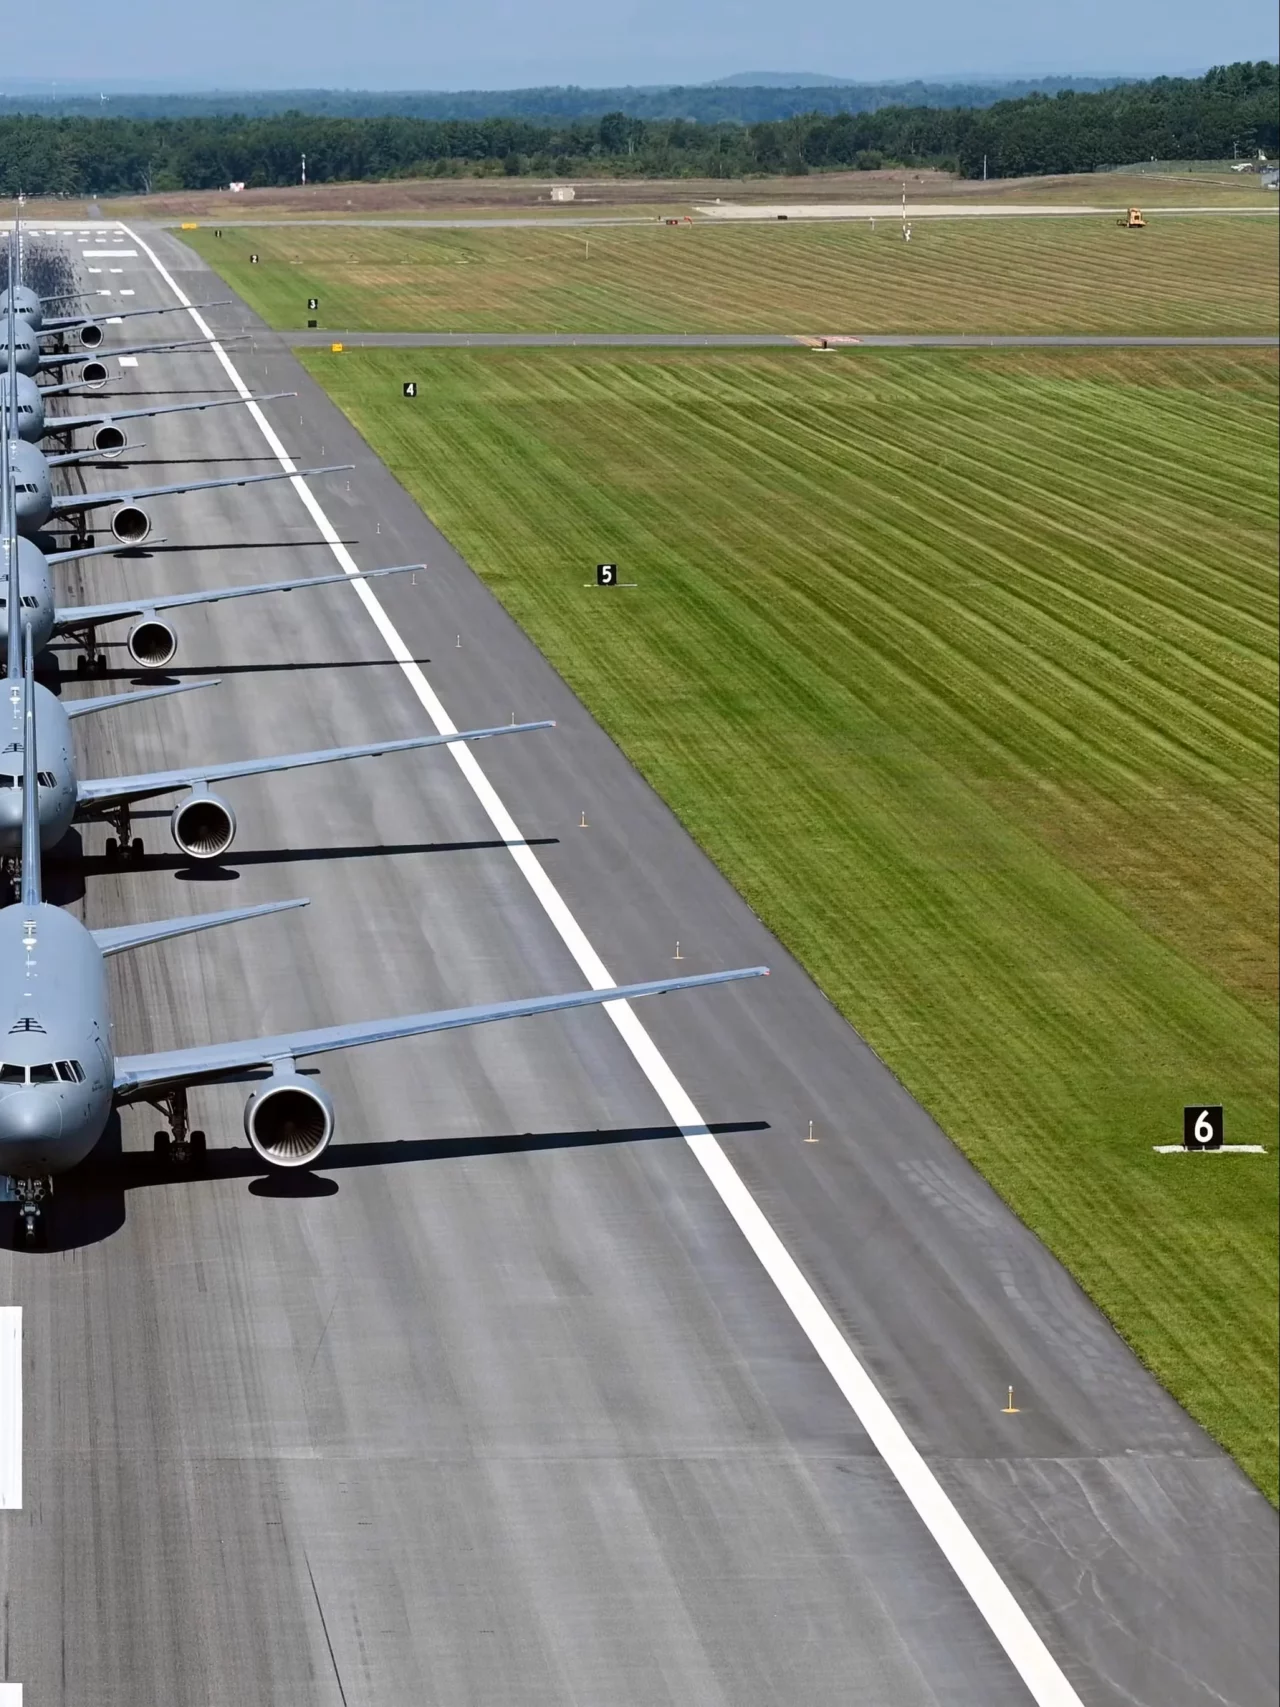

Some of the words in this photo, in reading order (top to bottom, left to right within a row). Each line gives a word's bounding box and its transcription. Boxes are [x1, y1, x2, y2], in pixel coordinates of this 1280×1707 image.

[406, 383, 414, 396] 4
[603, 565, 612, 583] 5
[1194, 1109, 1214, 1143] 6
